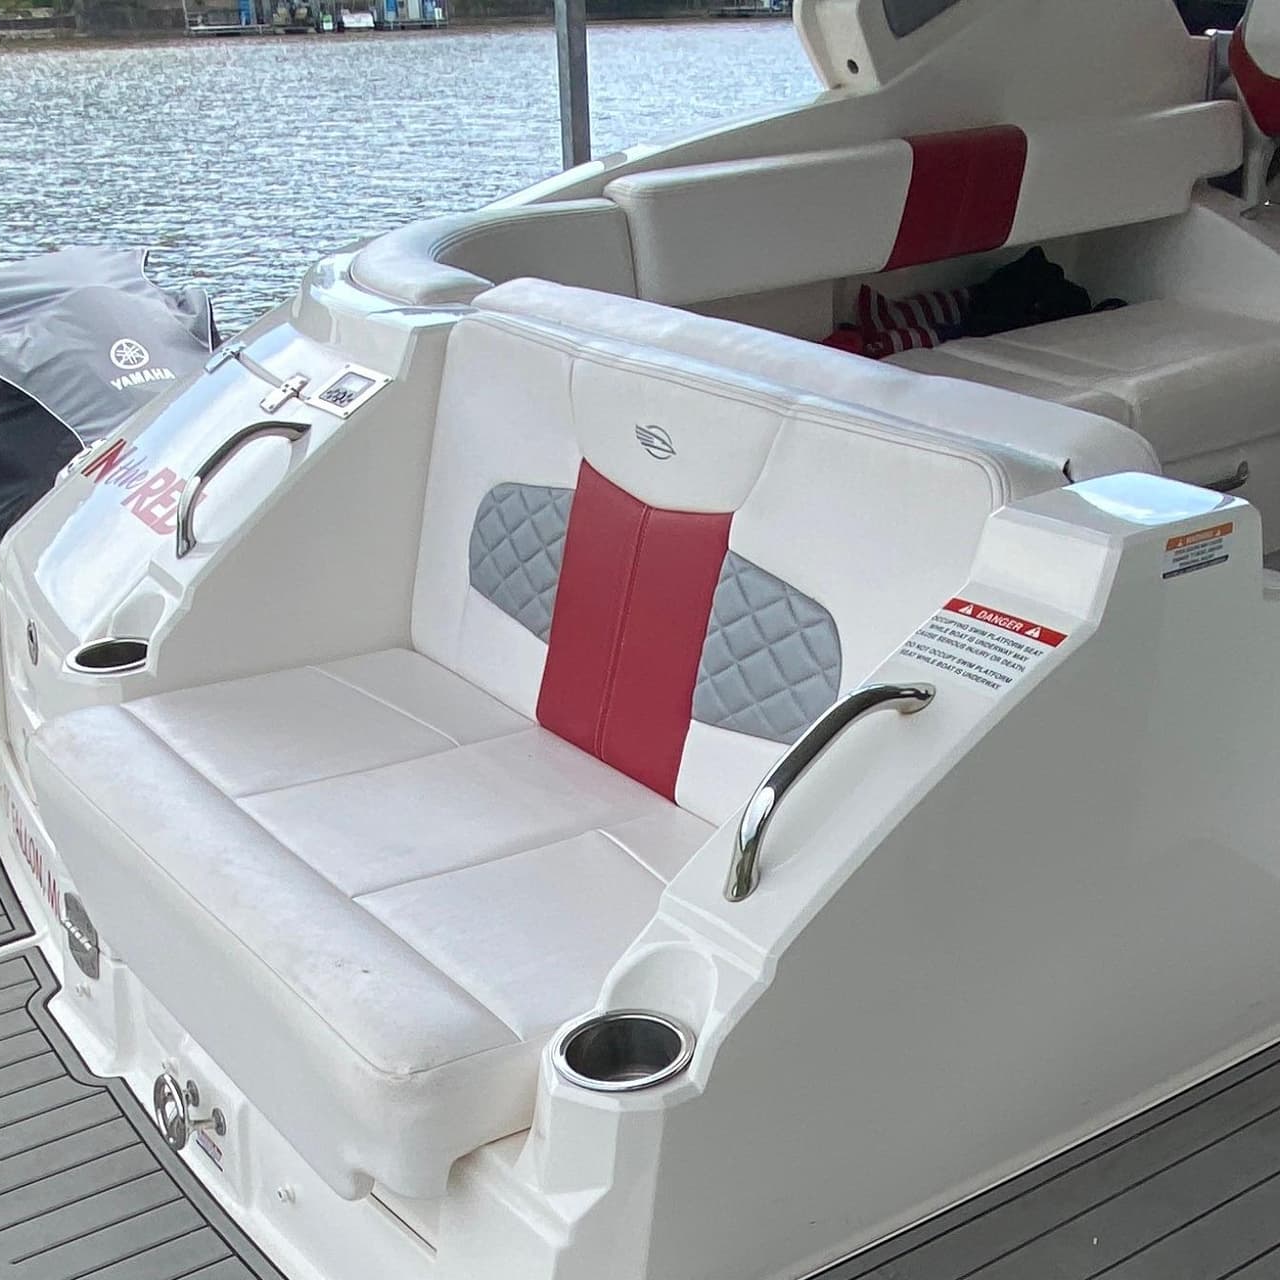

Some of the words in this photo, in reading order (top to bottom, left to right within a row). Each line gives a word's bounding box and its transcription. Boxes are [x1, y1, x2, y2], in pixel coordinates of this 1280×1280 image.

[110, 367, 176, 391] YAMAHA
[976, 610, 1023, 632] DANGER
[975, 638, 1014, 656] UNDERWAY
[1012, 651, 1030, 662] MAY
[987, 633, 1025, 650] PLATFORM
[1024, 646, 1044, 657] SEAT
[928, 648, 958, 661] OCCUPY
[974, 664, 1014, 684] PLATFORM
